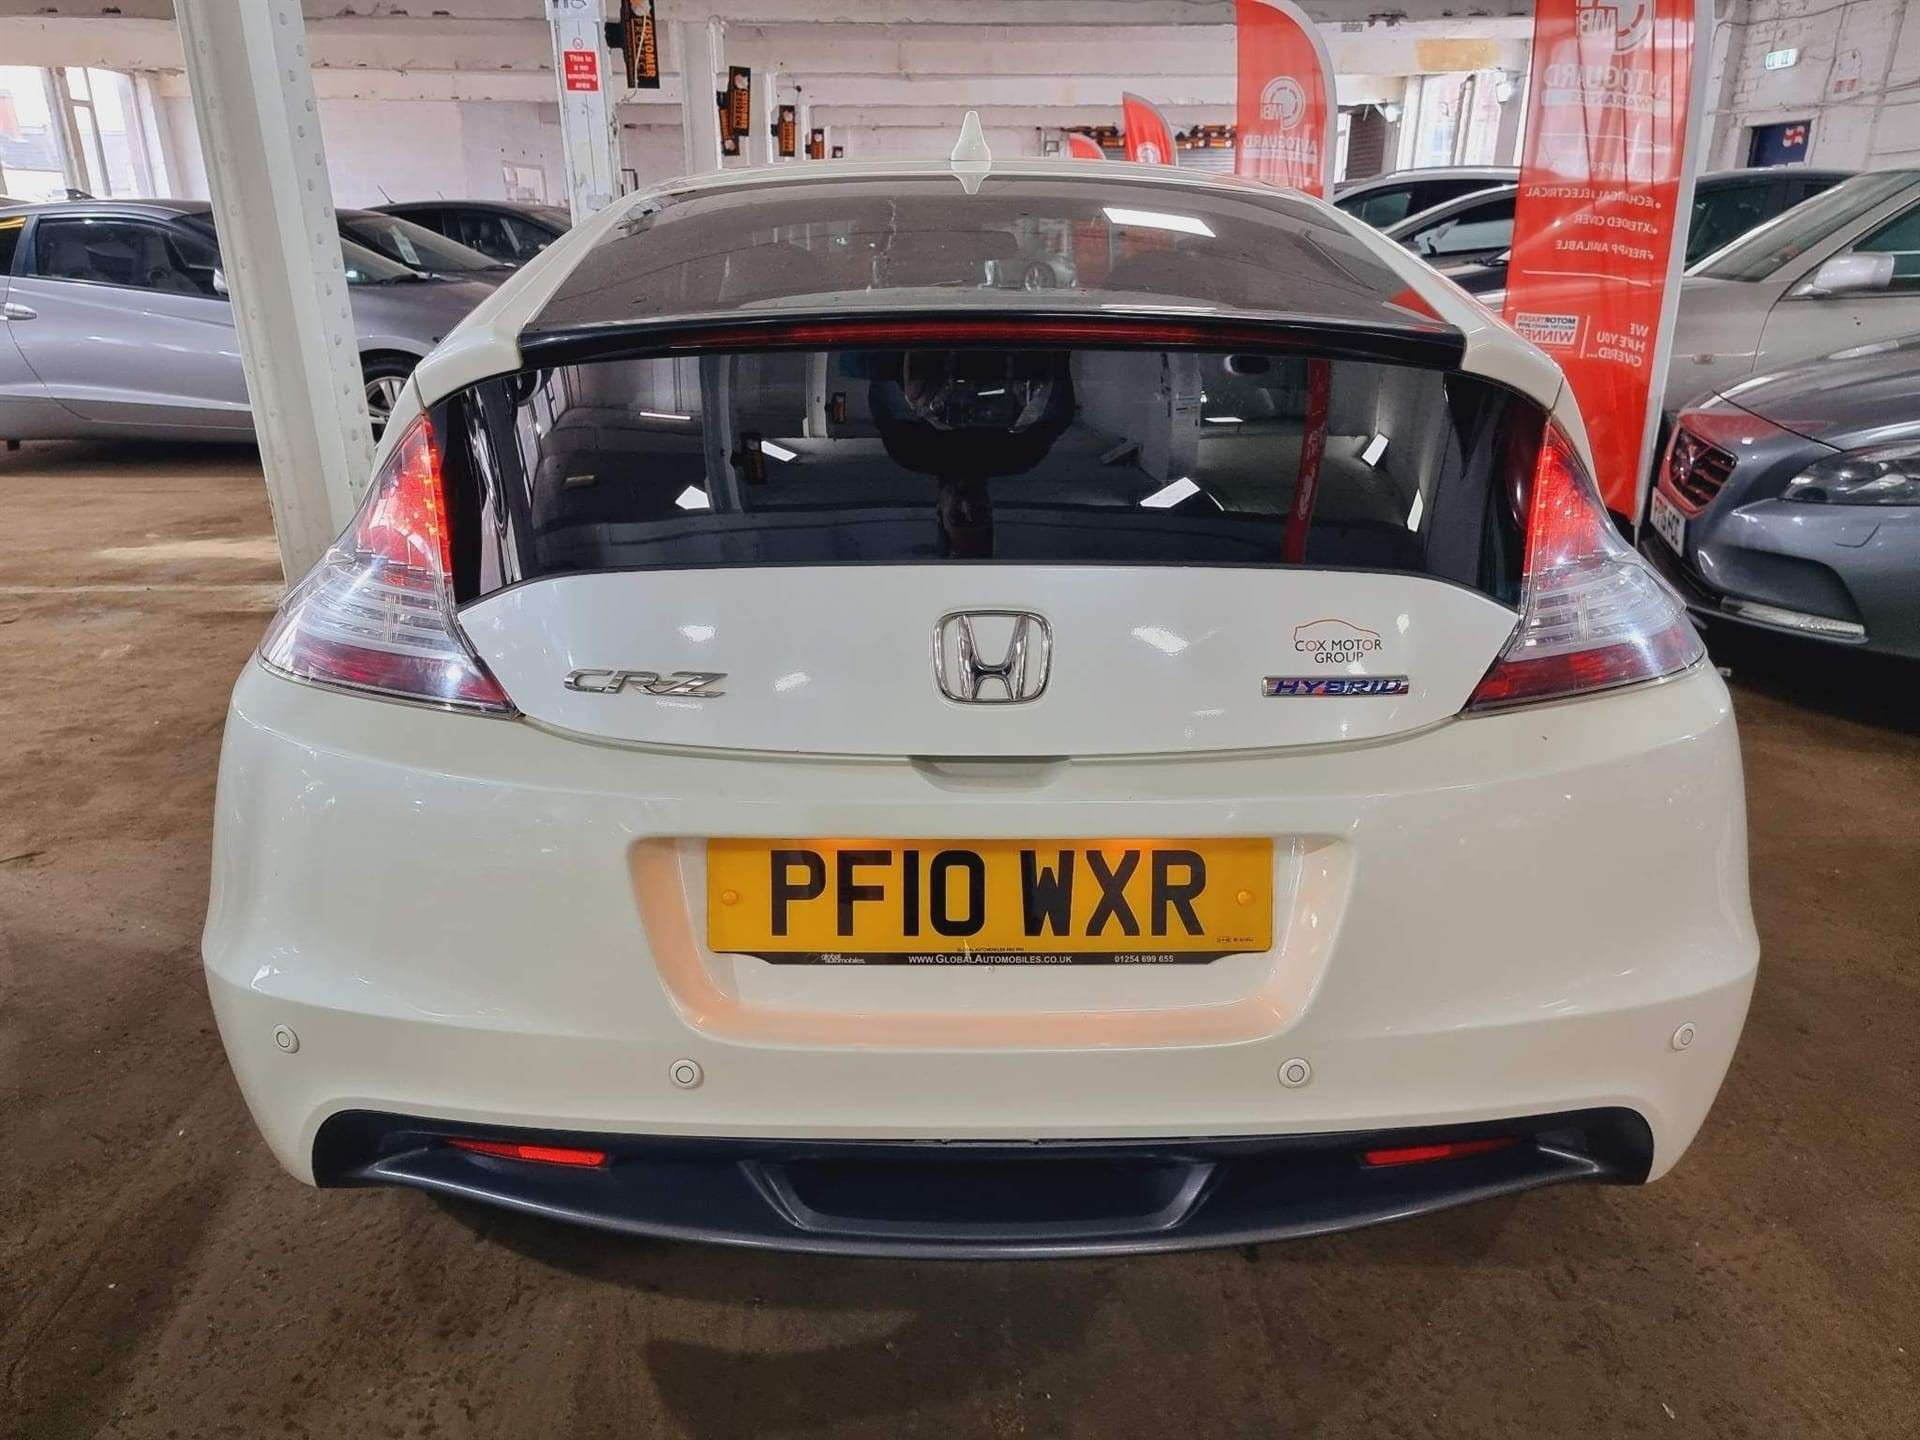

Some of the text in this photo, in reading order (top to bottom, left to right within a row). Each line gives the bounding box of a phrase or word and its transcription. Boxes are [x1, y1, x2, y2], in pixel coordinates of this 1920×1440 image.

[1294, 639, 1383, 652] COX MOTOR
[1314, 651, 1364, 664] GROUP
[1275, 678, 1402, 694] HYBRID
[770, 849, 1207, 937] PF10 WXR
[1114, 954, 1140, 964] 01254
